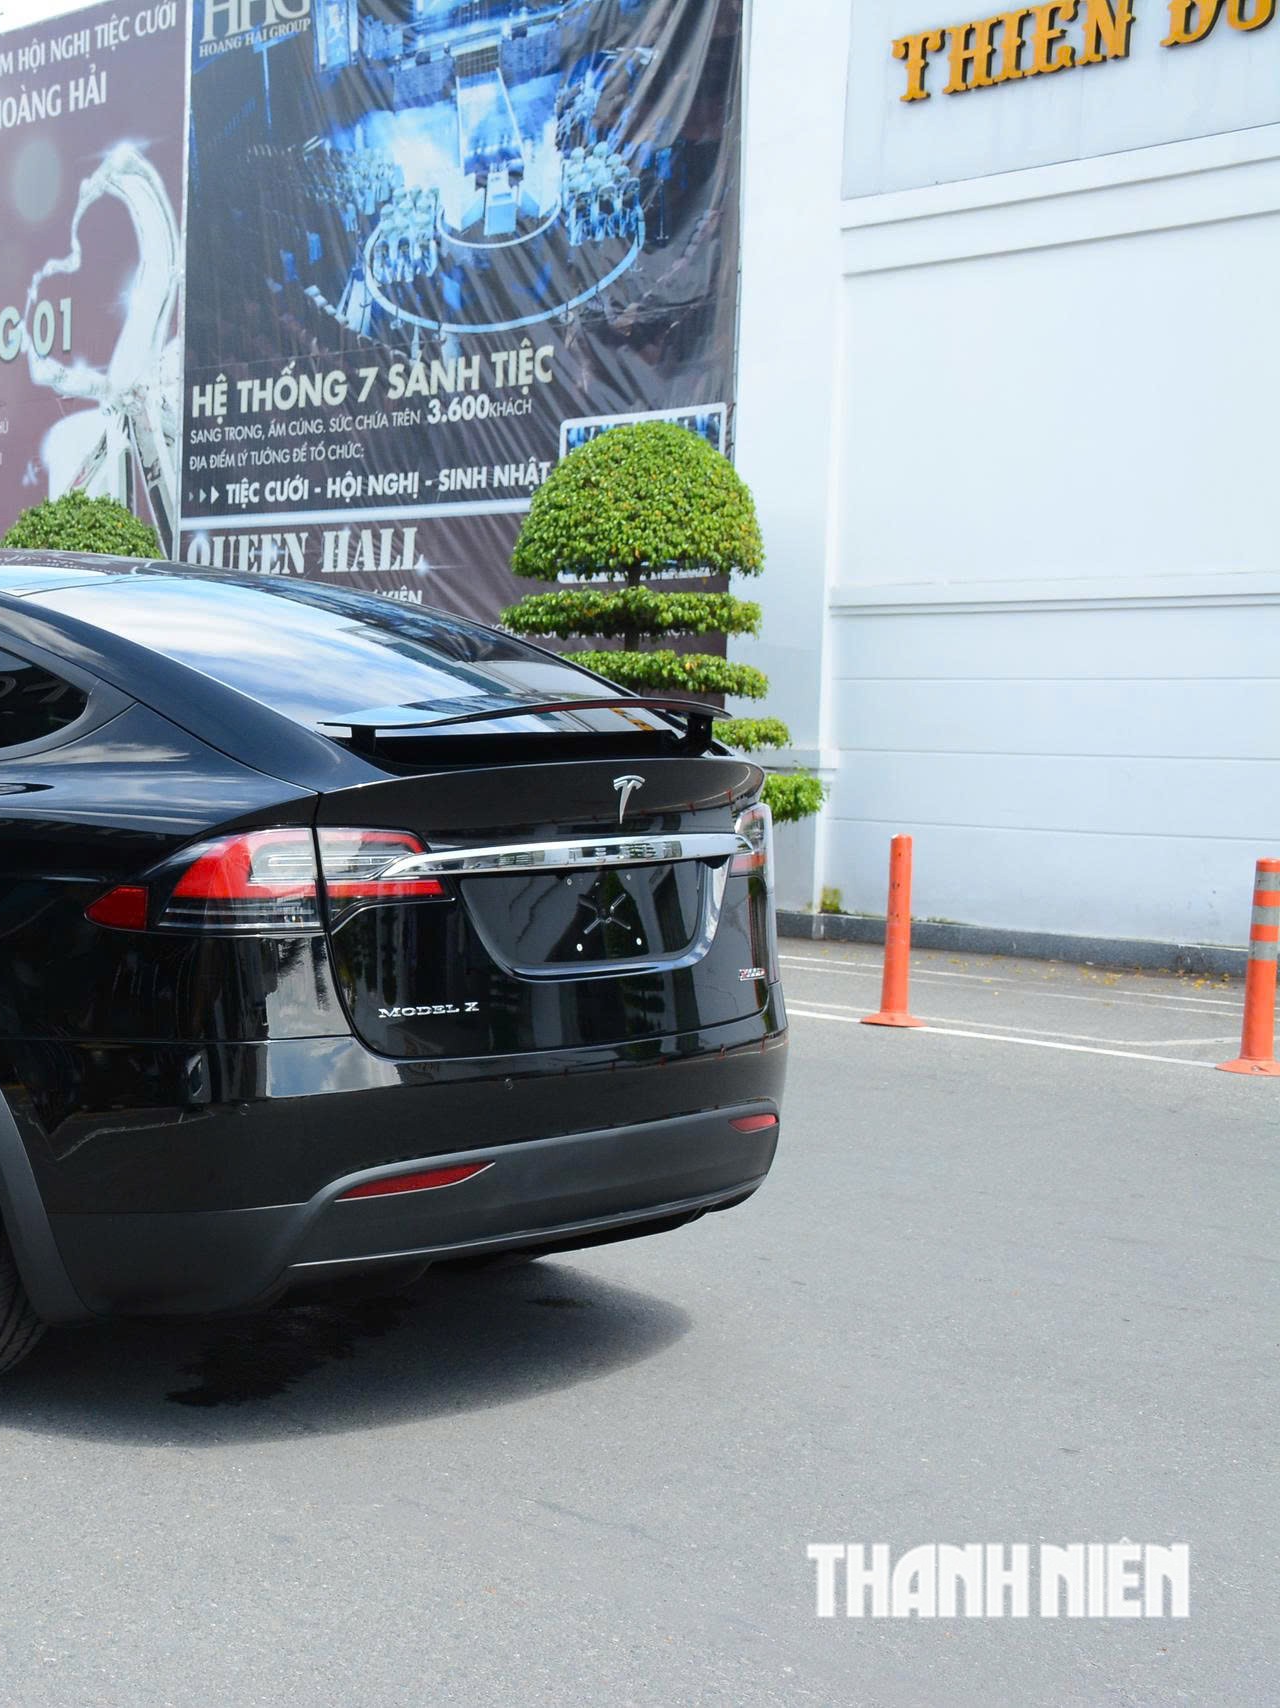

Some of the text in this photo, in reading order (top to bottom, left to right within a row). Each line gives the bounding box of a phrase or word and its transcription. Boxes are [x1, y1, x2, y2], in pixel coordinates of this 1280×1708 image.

[18, 37, 46, 74] HỘI
[49, 27, 91, 63] NGHỊ
[94, 12, 131, 51] TIỆC
[199, 18, 311, 58] HOANG HAI GROUP
[68, 63, 107, 113] HẢI
[32, 296, 72, 358] 01
[192, 373, 228, 424] HỆ
[236, 360, 348, 414] THỐNG
[357, 366, 380, 403] 7
[491, 337, 556, 395] TIỆC
[189, 427, 222, 445] SANG
[329, 413, 353, 434] SỨC
[355, 410, 390, 431] CHỨA
[392, 406, 421, 428] TRÊN
[189, 455, 208, 473] ĐỊA
[237, 450, 249, 467] LÝ
[327, 442, 365, 461] CHỨC:
[226, 477, 261, 509] TIỆC
[264, 473, 310, 502] CƯỚI
[326, 471, 363, 503] HỘI
[367, 471, 420, 499] NGHỊ
[438, 465, 488, 492] SINH
[493, 455, 552, 491] NHẬT
[320, 526, 425, 573] HALL
[377, 1001, 480, 1019] MODEL X
